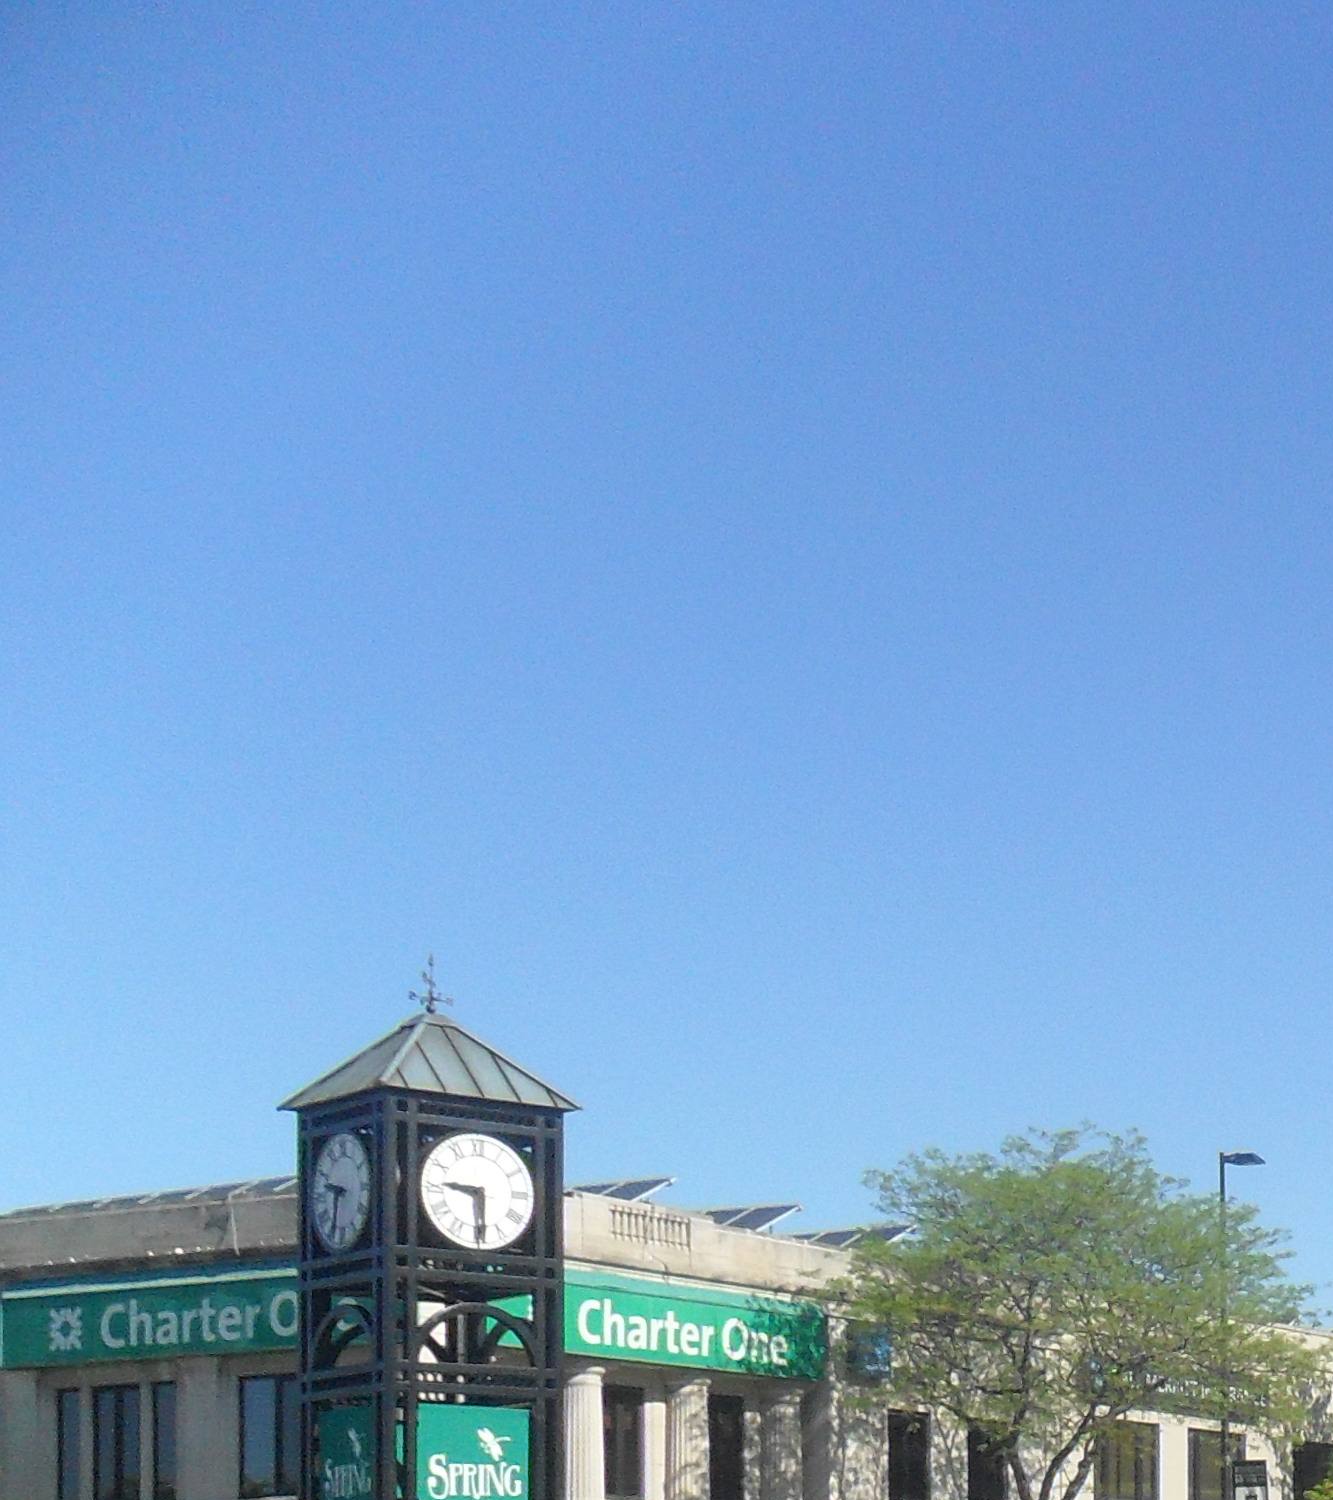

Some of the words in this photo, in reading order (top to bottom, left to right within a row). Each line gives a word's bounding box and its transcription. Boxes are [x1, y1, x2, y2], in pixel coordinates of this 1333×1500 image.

[100, 1298, 260, 1348] Charter
[577, 1298, 714, 1357] Charter
[722, 1317, 788, 1366] One
[426, 1453, 522, 1500] SPRING
